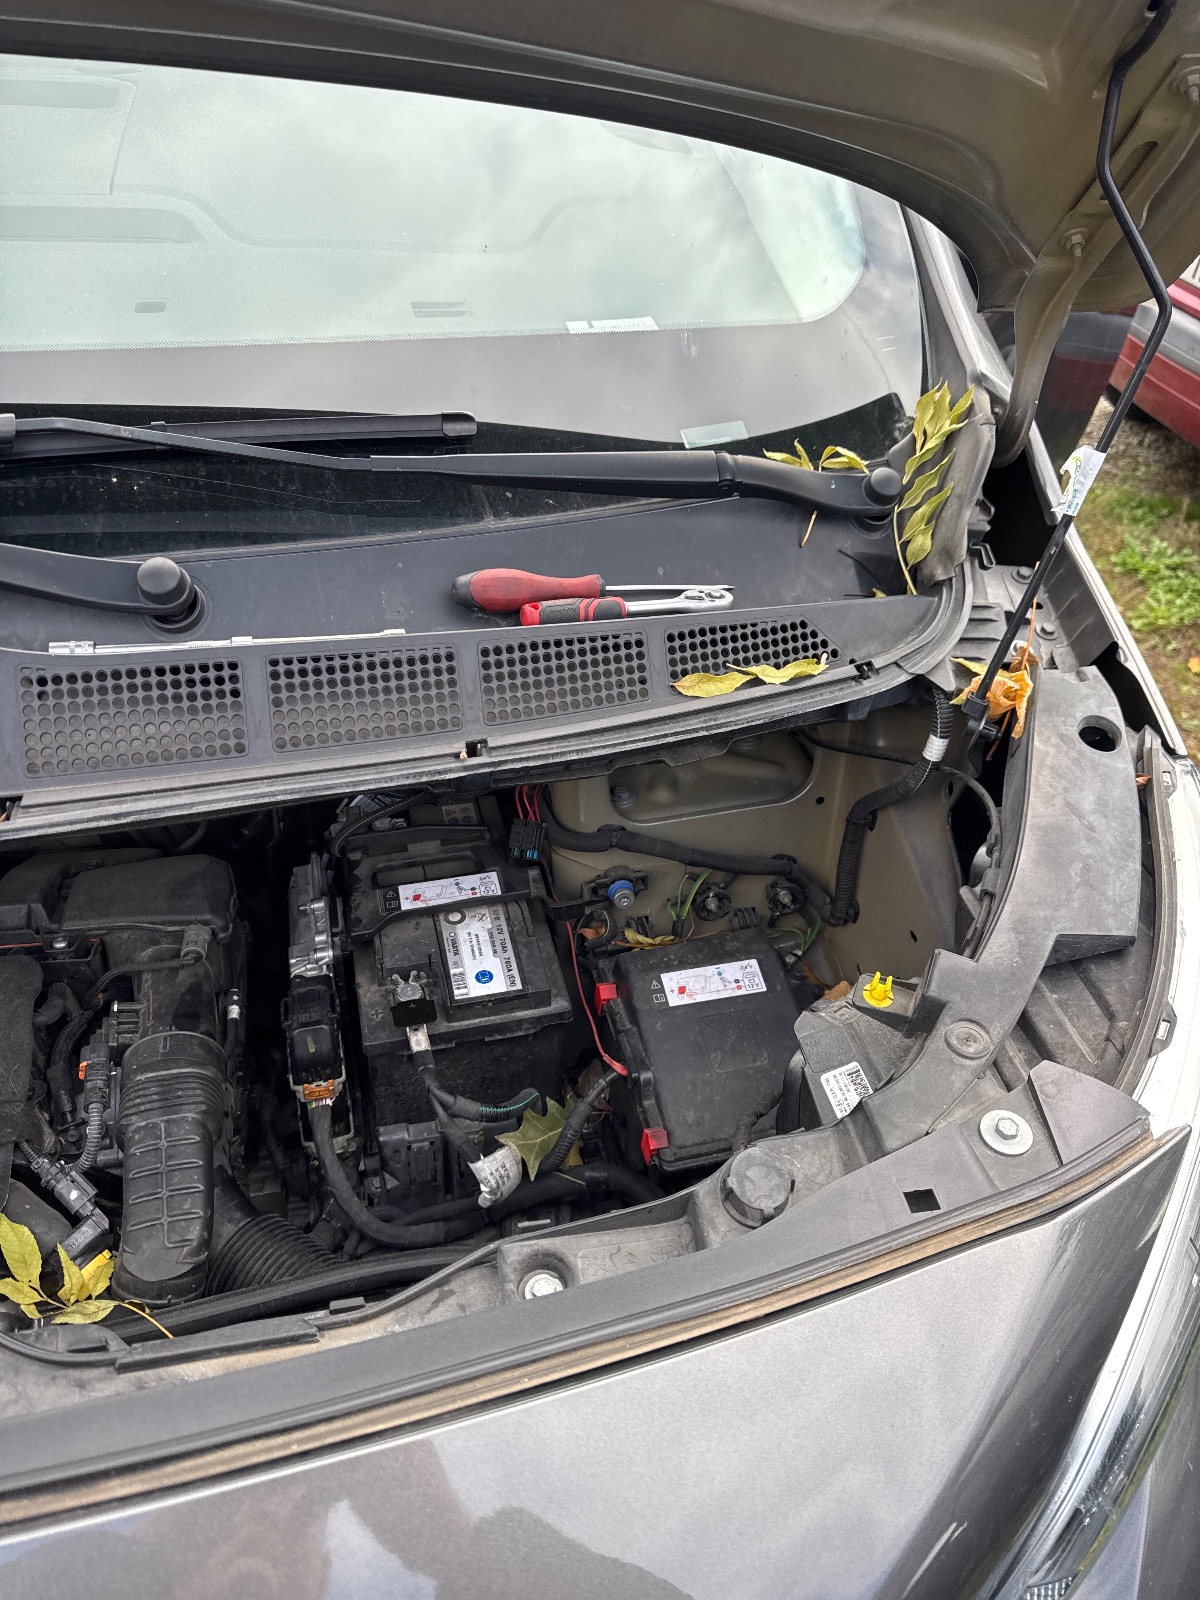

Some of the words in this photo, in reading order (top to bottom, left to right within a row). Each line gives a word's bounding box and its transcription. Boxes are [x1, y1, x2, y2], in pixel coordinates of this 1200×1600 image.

[492, 909, 501, 921] EFB
[496, 924, 504, 935] 12V
[450, 937, 459, 957] VARTA
[499, 938, 509, 954] 70Ah
[503, 957, 513, 973] 760A
[507, 973, 517, 988] (EN)
